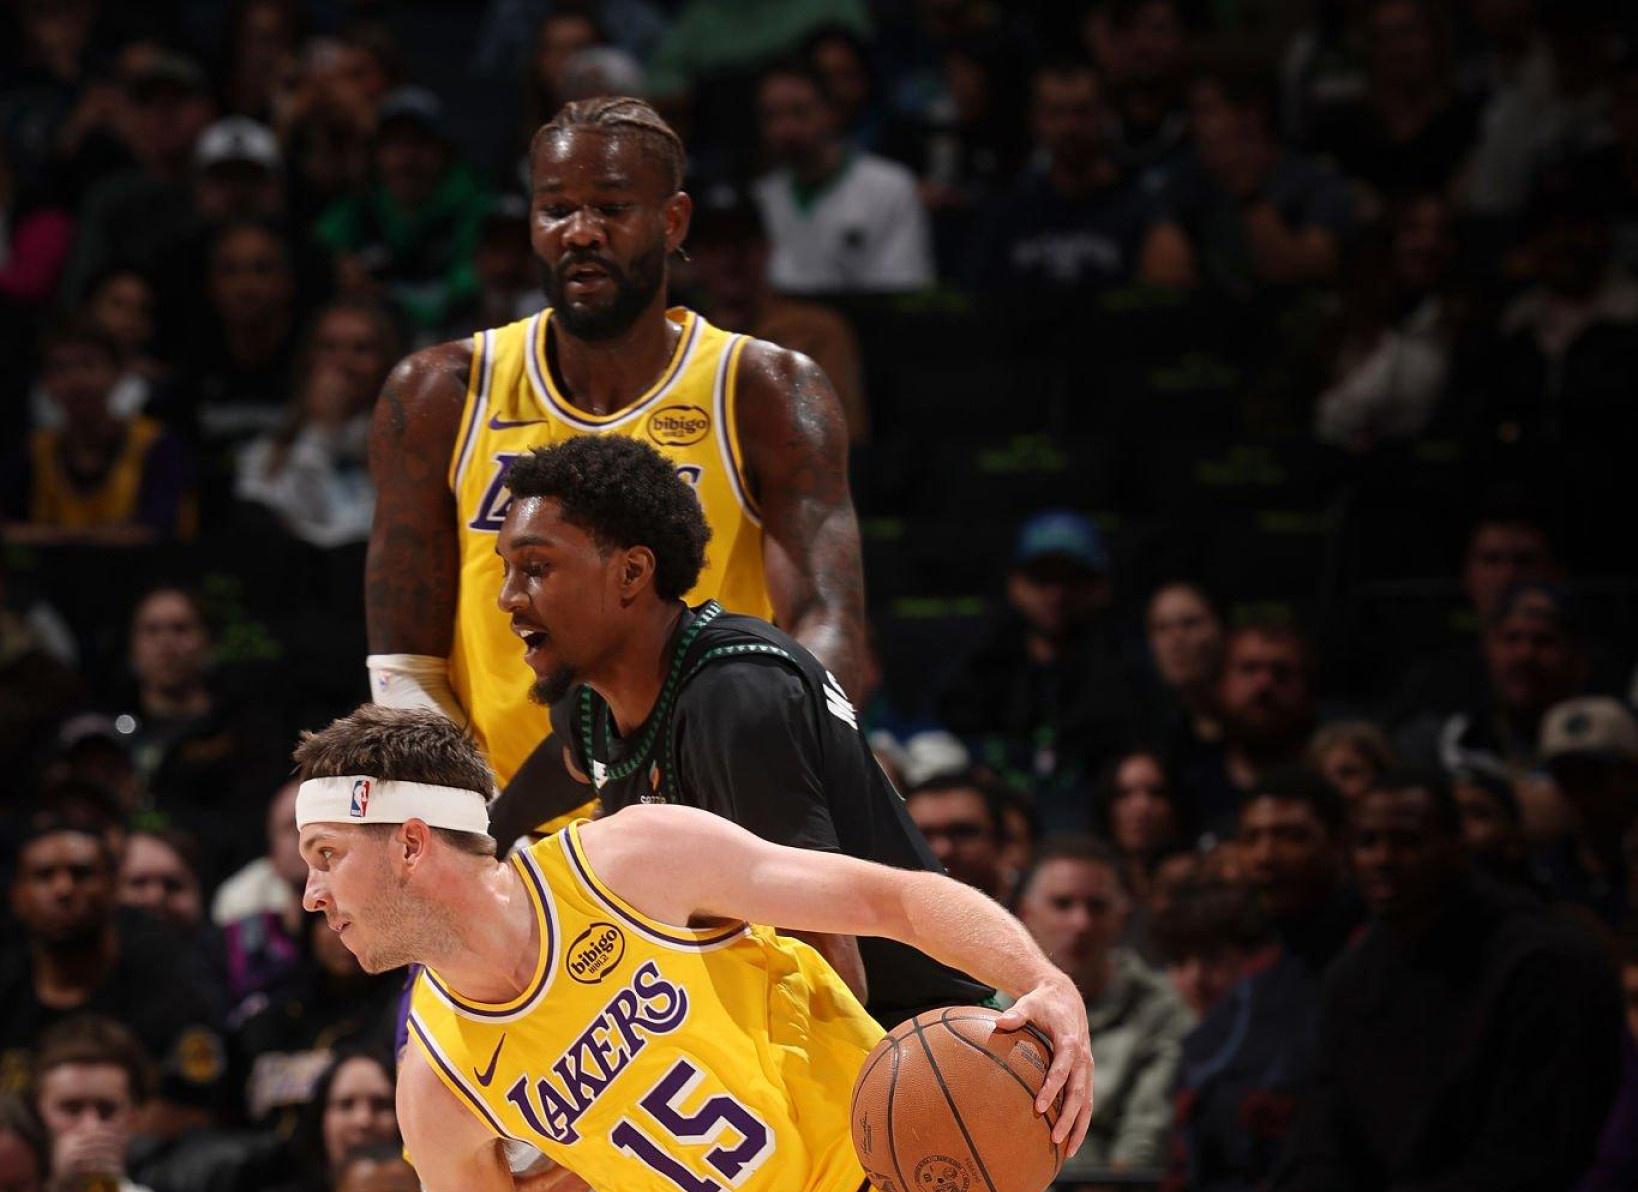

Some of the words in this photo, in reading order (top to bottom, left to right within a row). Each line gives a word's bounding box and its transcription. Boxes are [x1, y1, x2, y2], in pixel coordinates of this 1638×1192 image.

[653, 416, 706, 434] bibigo
[571, 929, 617, 974] bibigo
[507, 961, 688, 1145] LAKERS
